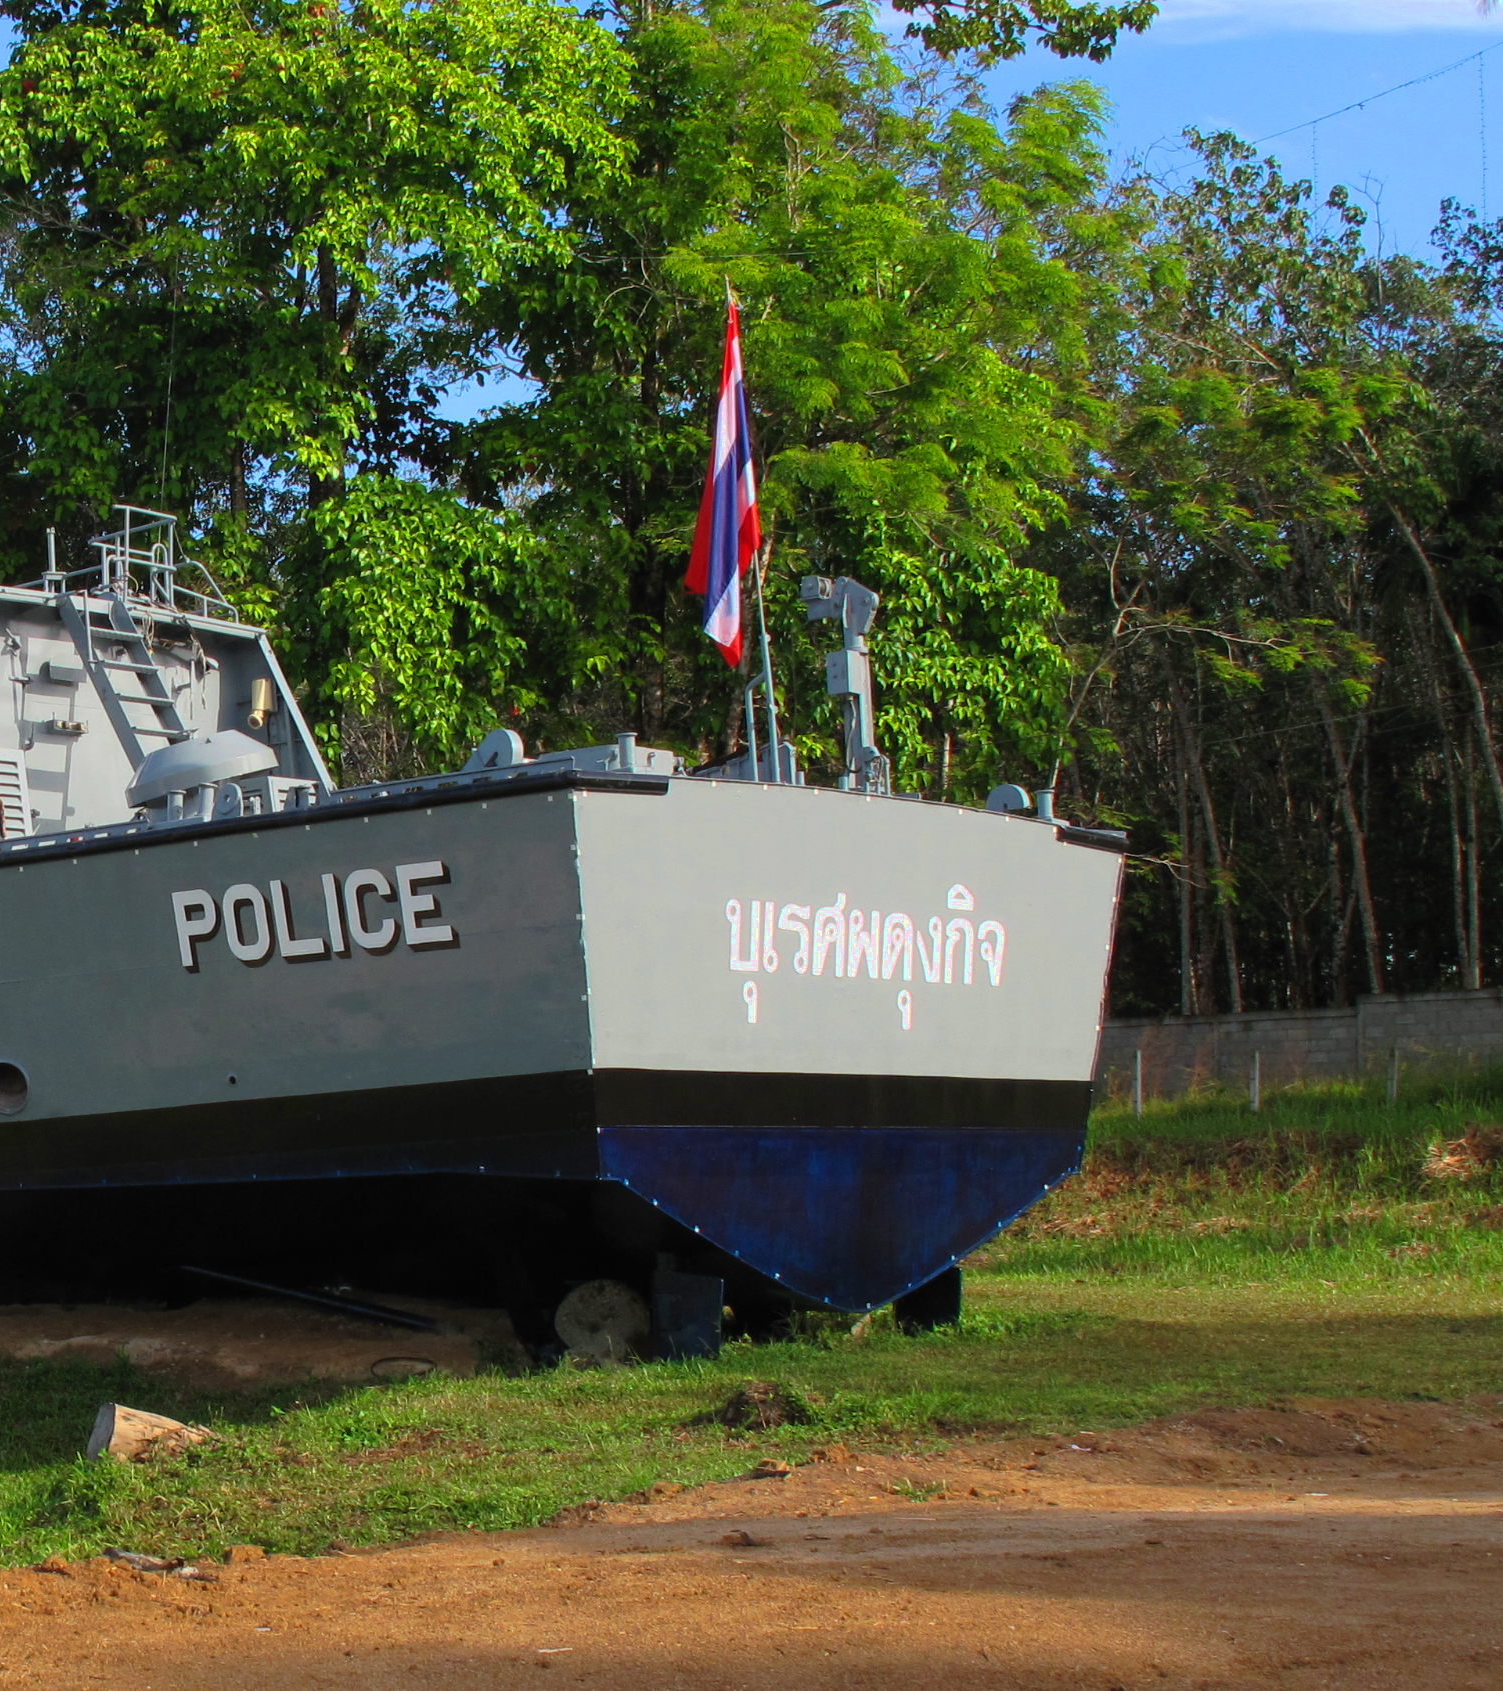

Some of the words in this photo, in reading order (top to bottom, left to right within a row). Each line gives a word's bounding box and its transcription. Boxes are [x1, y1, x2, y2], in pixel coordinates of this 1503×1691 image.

[171, 861, 457, 970] POLICE
[725, 883, 1006, 1031] บุเรศผดุงกิจ
